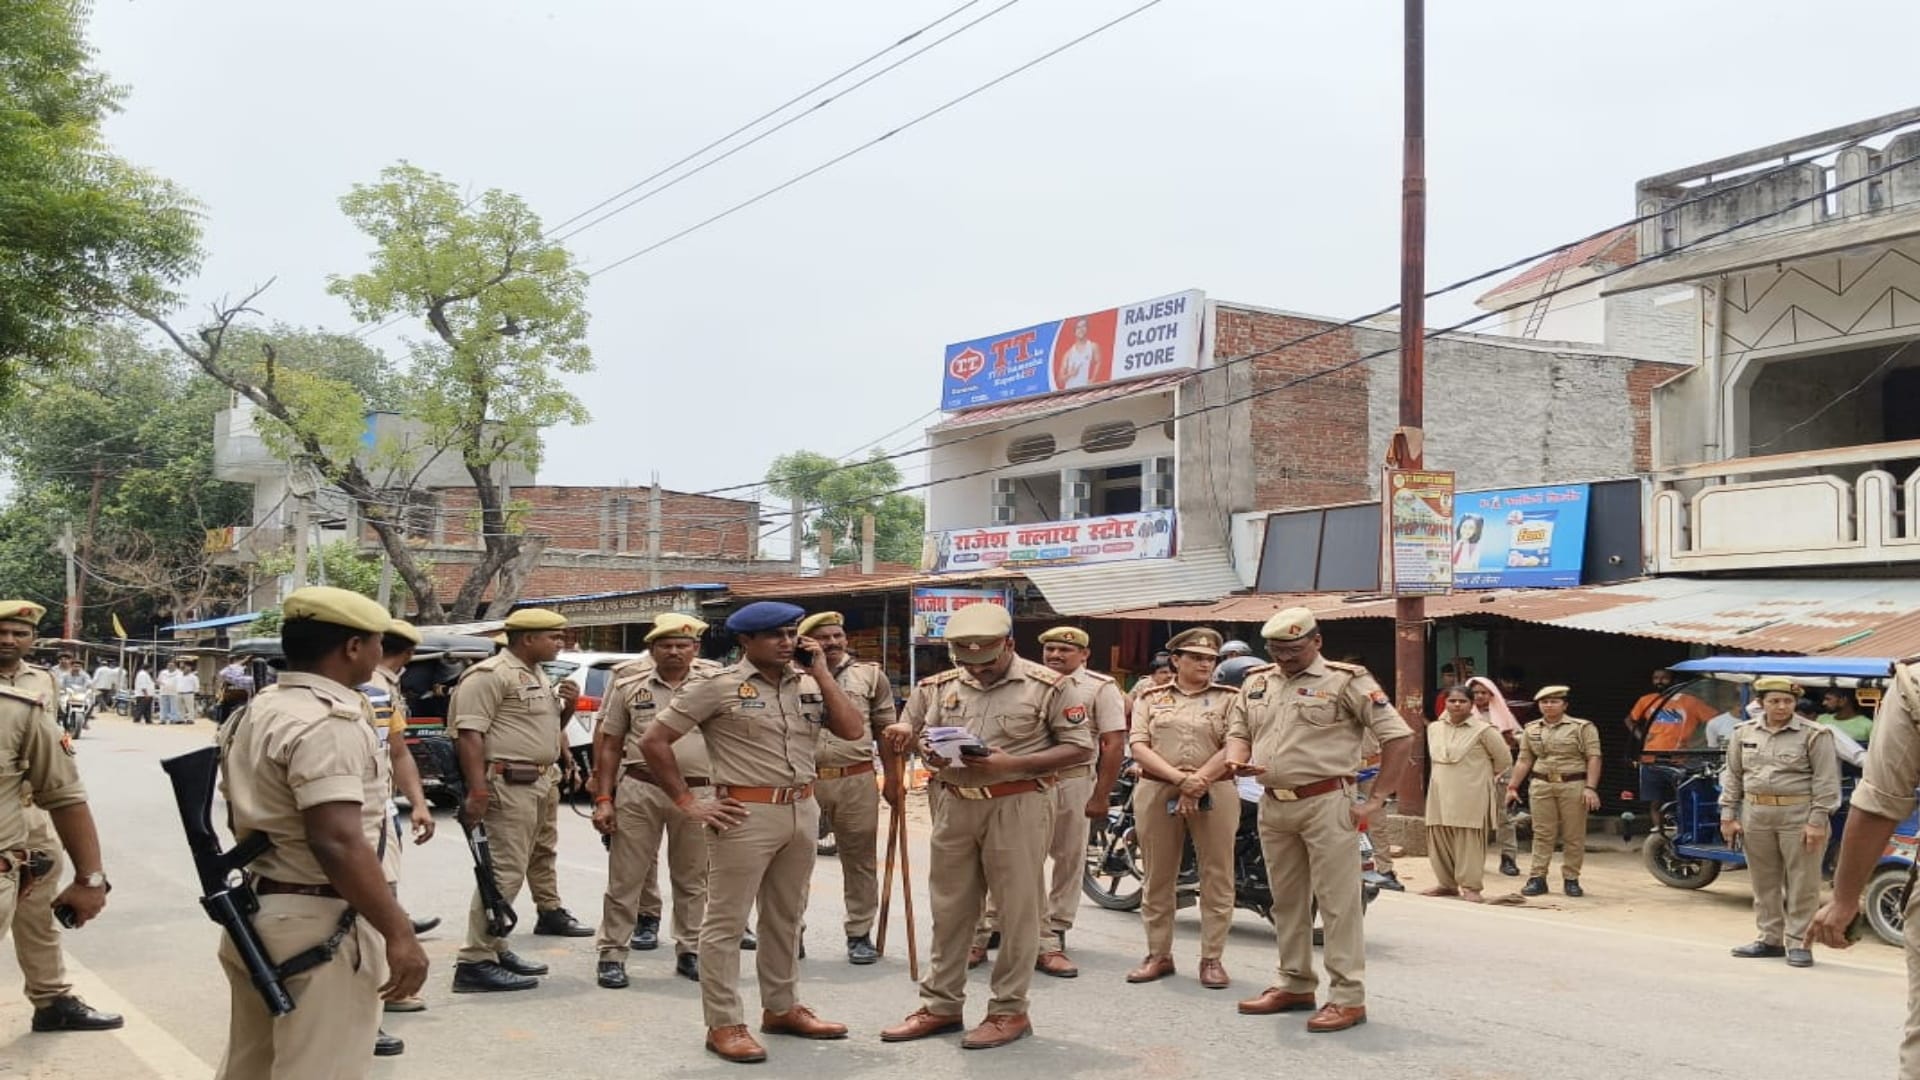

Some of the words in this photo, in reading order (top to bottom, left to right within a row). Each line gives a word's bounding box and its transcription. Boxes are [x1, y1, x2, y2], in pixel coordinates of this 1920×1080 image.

[1125, 297, 1186, 325] RAJESH
[1127, 322, 1178, 347] CLOTH
[1124, 346, 1176, 370] STORE
[954, 530, 1010, 549] राजेश
[1088, 518, 1137, 539] स्टोर
